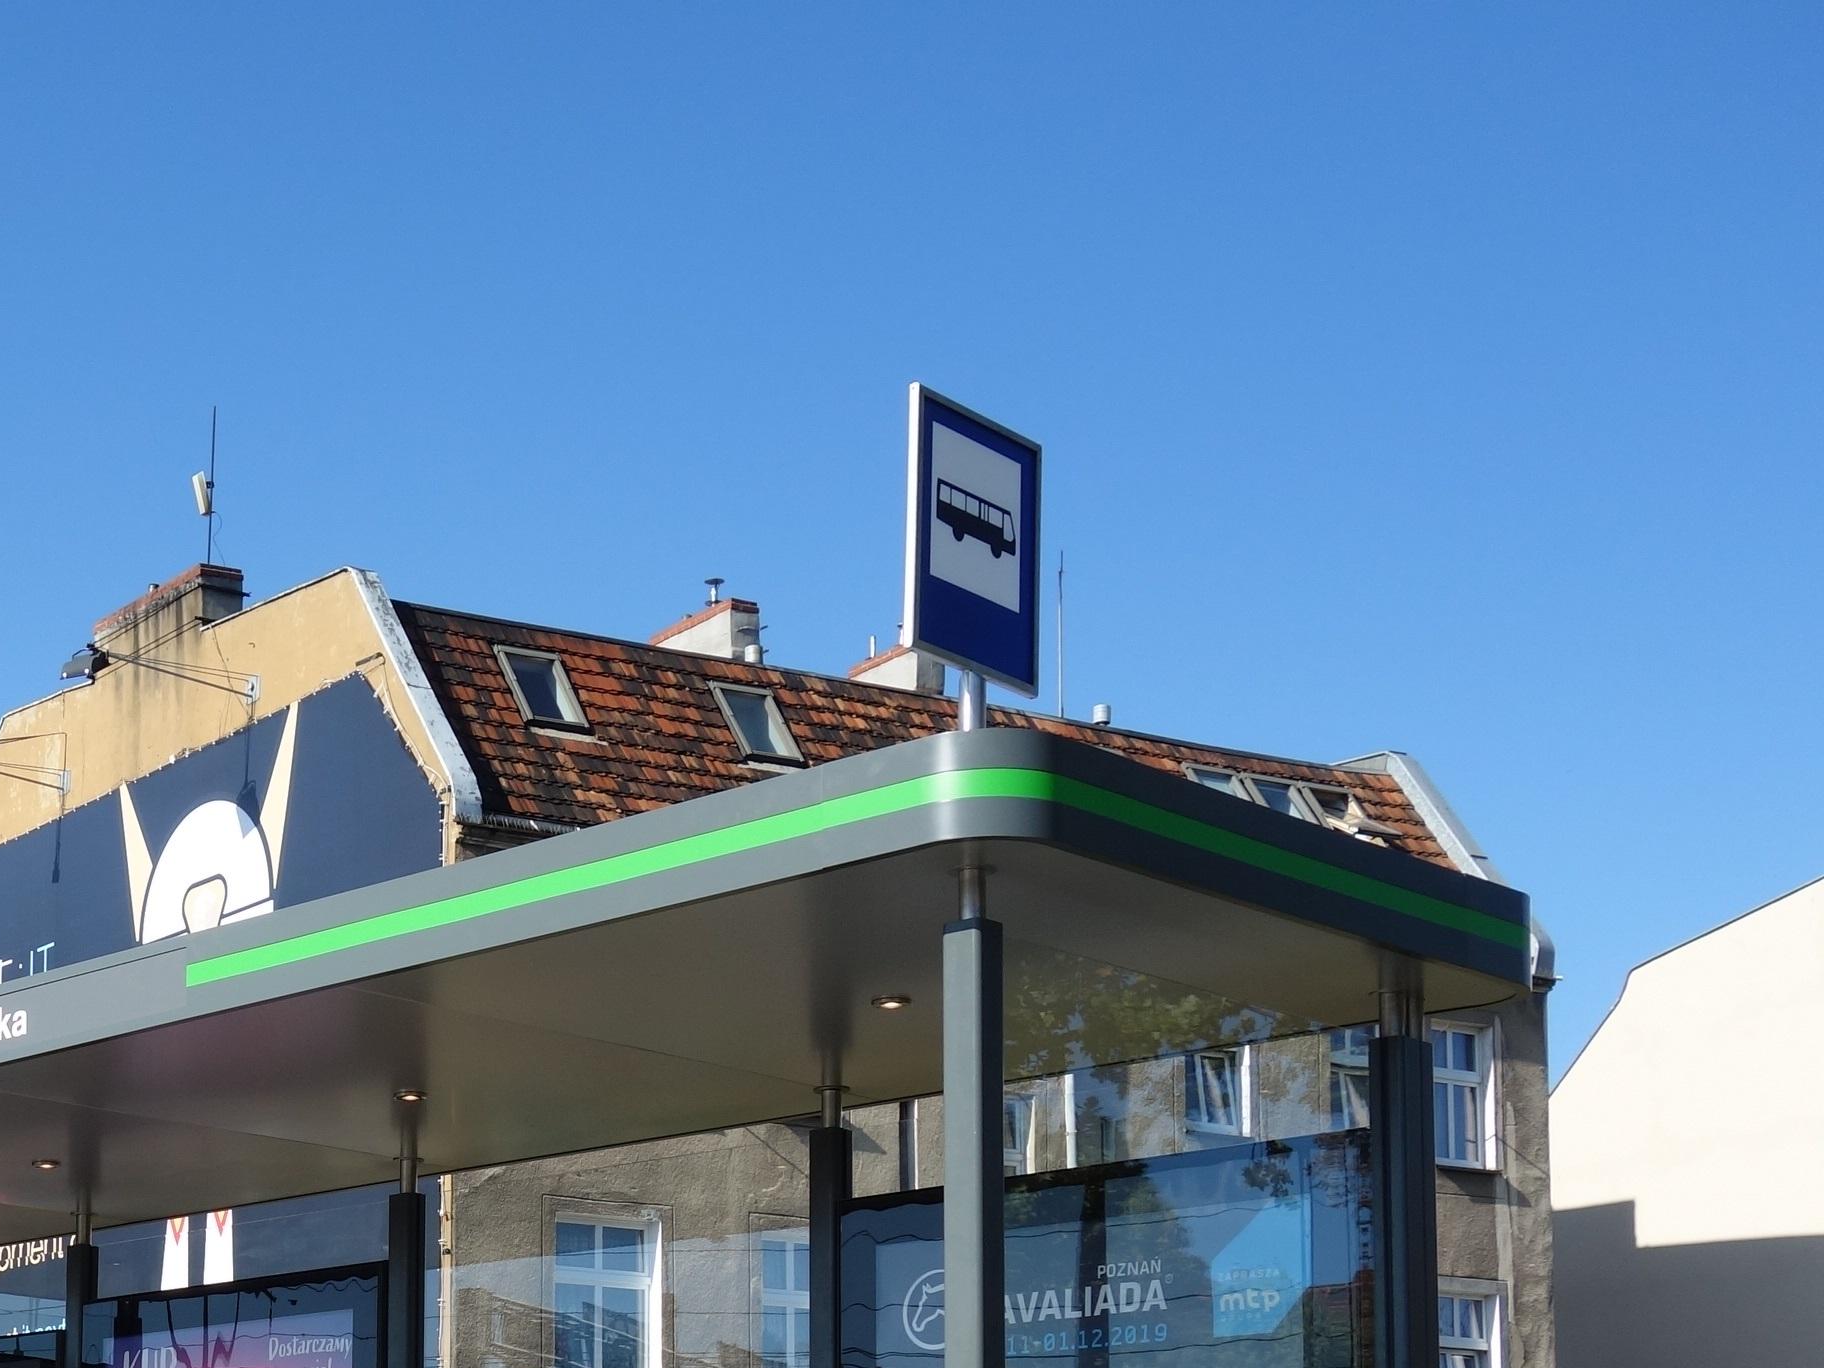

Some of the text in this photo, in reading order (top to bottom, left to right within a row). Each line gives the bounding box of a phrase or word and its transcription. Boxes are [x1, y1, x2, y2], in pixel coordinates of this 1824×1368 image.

[1096, 1256, 1162, 1279] POZNAŃ
[1004, 1279, 1169, 1325] AVALIADA
[1220, 1289, 1280, 1312] mtp
[268, 1336, 353, 1360] Dostarczamy
[1006, 1323, 1168, 1355] 11-01.12.2019
